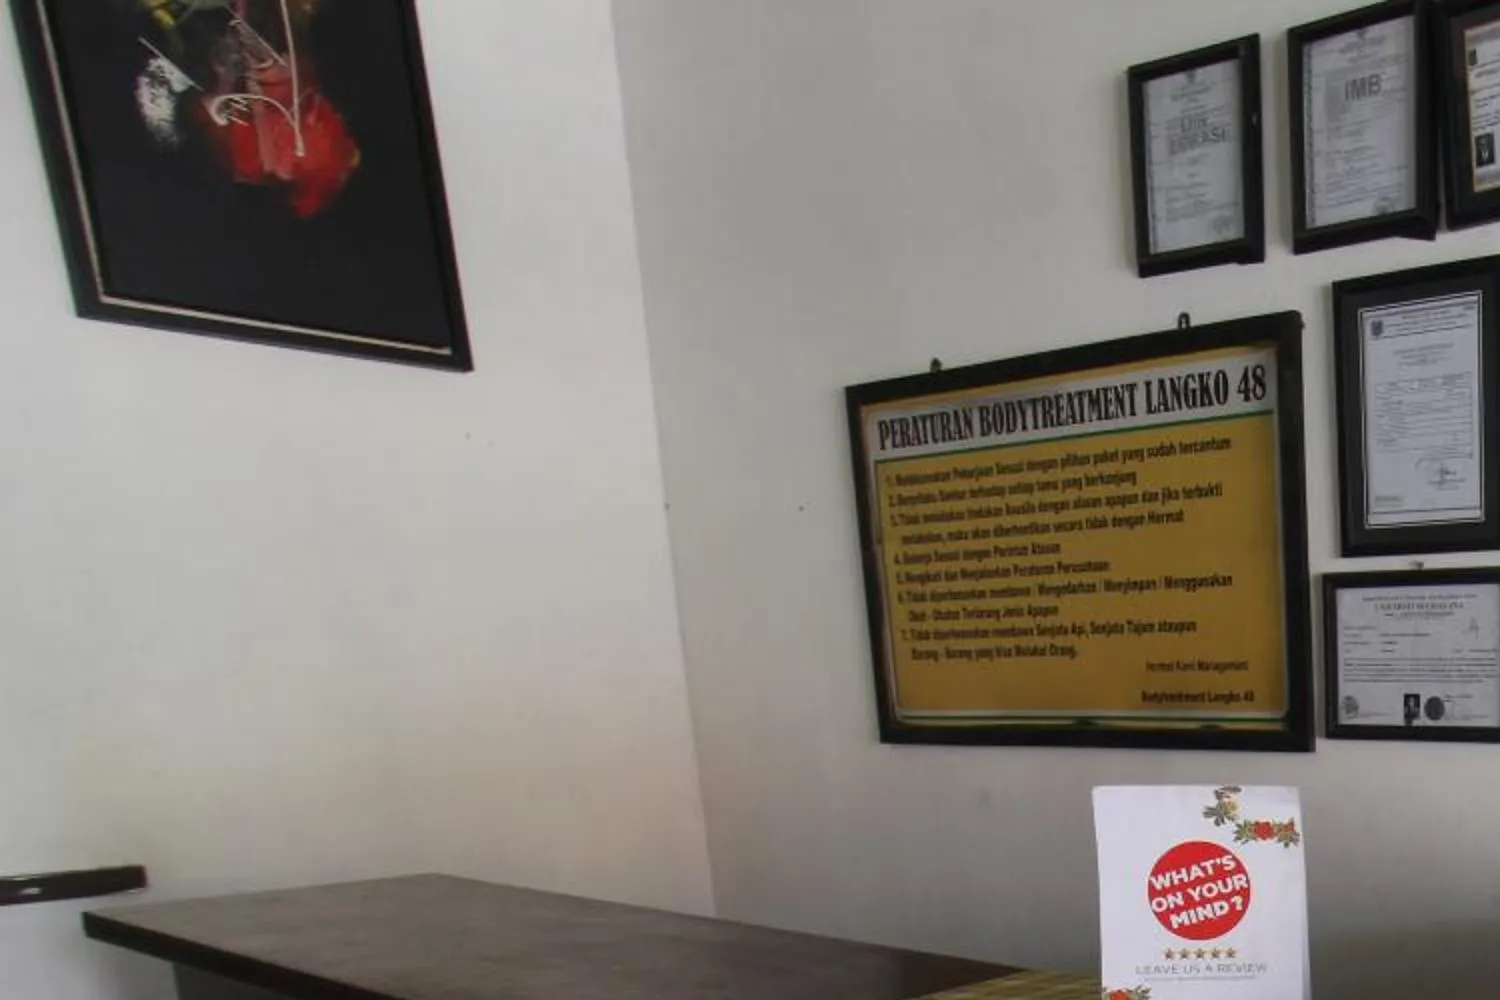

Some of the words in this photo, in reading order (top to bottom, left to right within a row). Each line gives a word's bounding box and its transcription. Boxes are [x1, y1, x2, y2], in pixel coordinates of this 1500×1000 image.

[878, 407, 974, 450] PERATURAN
[979, 382, 1137, 436] BODYTREATMENT
[1144, 369, 1229, 414] LANGKO
[1237, 364, 1267, 402] 48
[1121, 448, 1144, 464] yang
[1151, 855, 1236, 890] WHAT'S
[1152, 892, 1184, 913] ON
[1187, 874, 1249, 901] YOUR
[1169, 901, 1229, 929] MIND
[1135, 963, 1180, 975] LEAVE
[1184, 963, 1201, 974] US
[1205, 963, 1214, 973] A
[1217, 962, 1268, 973] REVIEW
